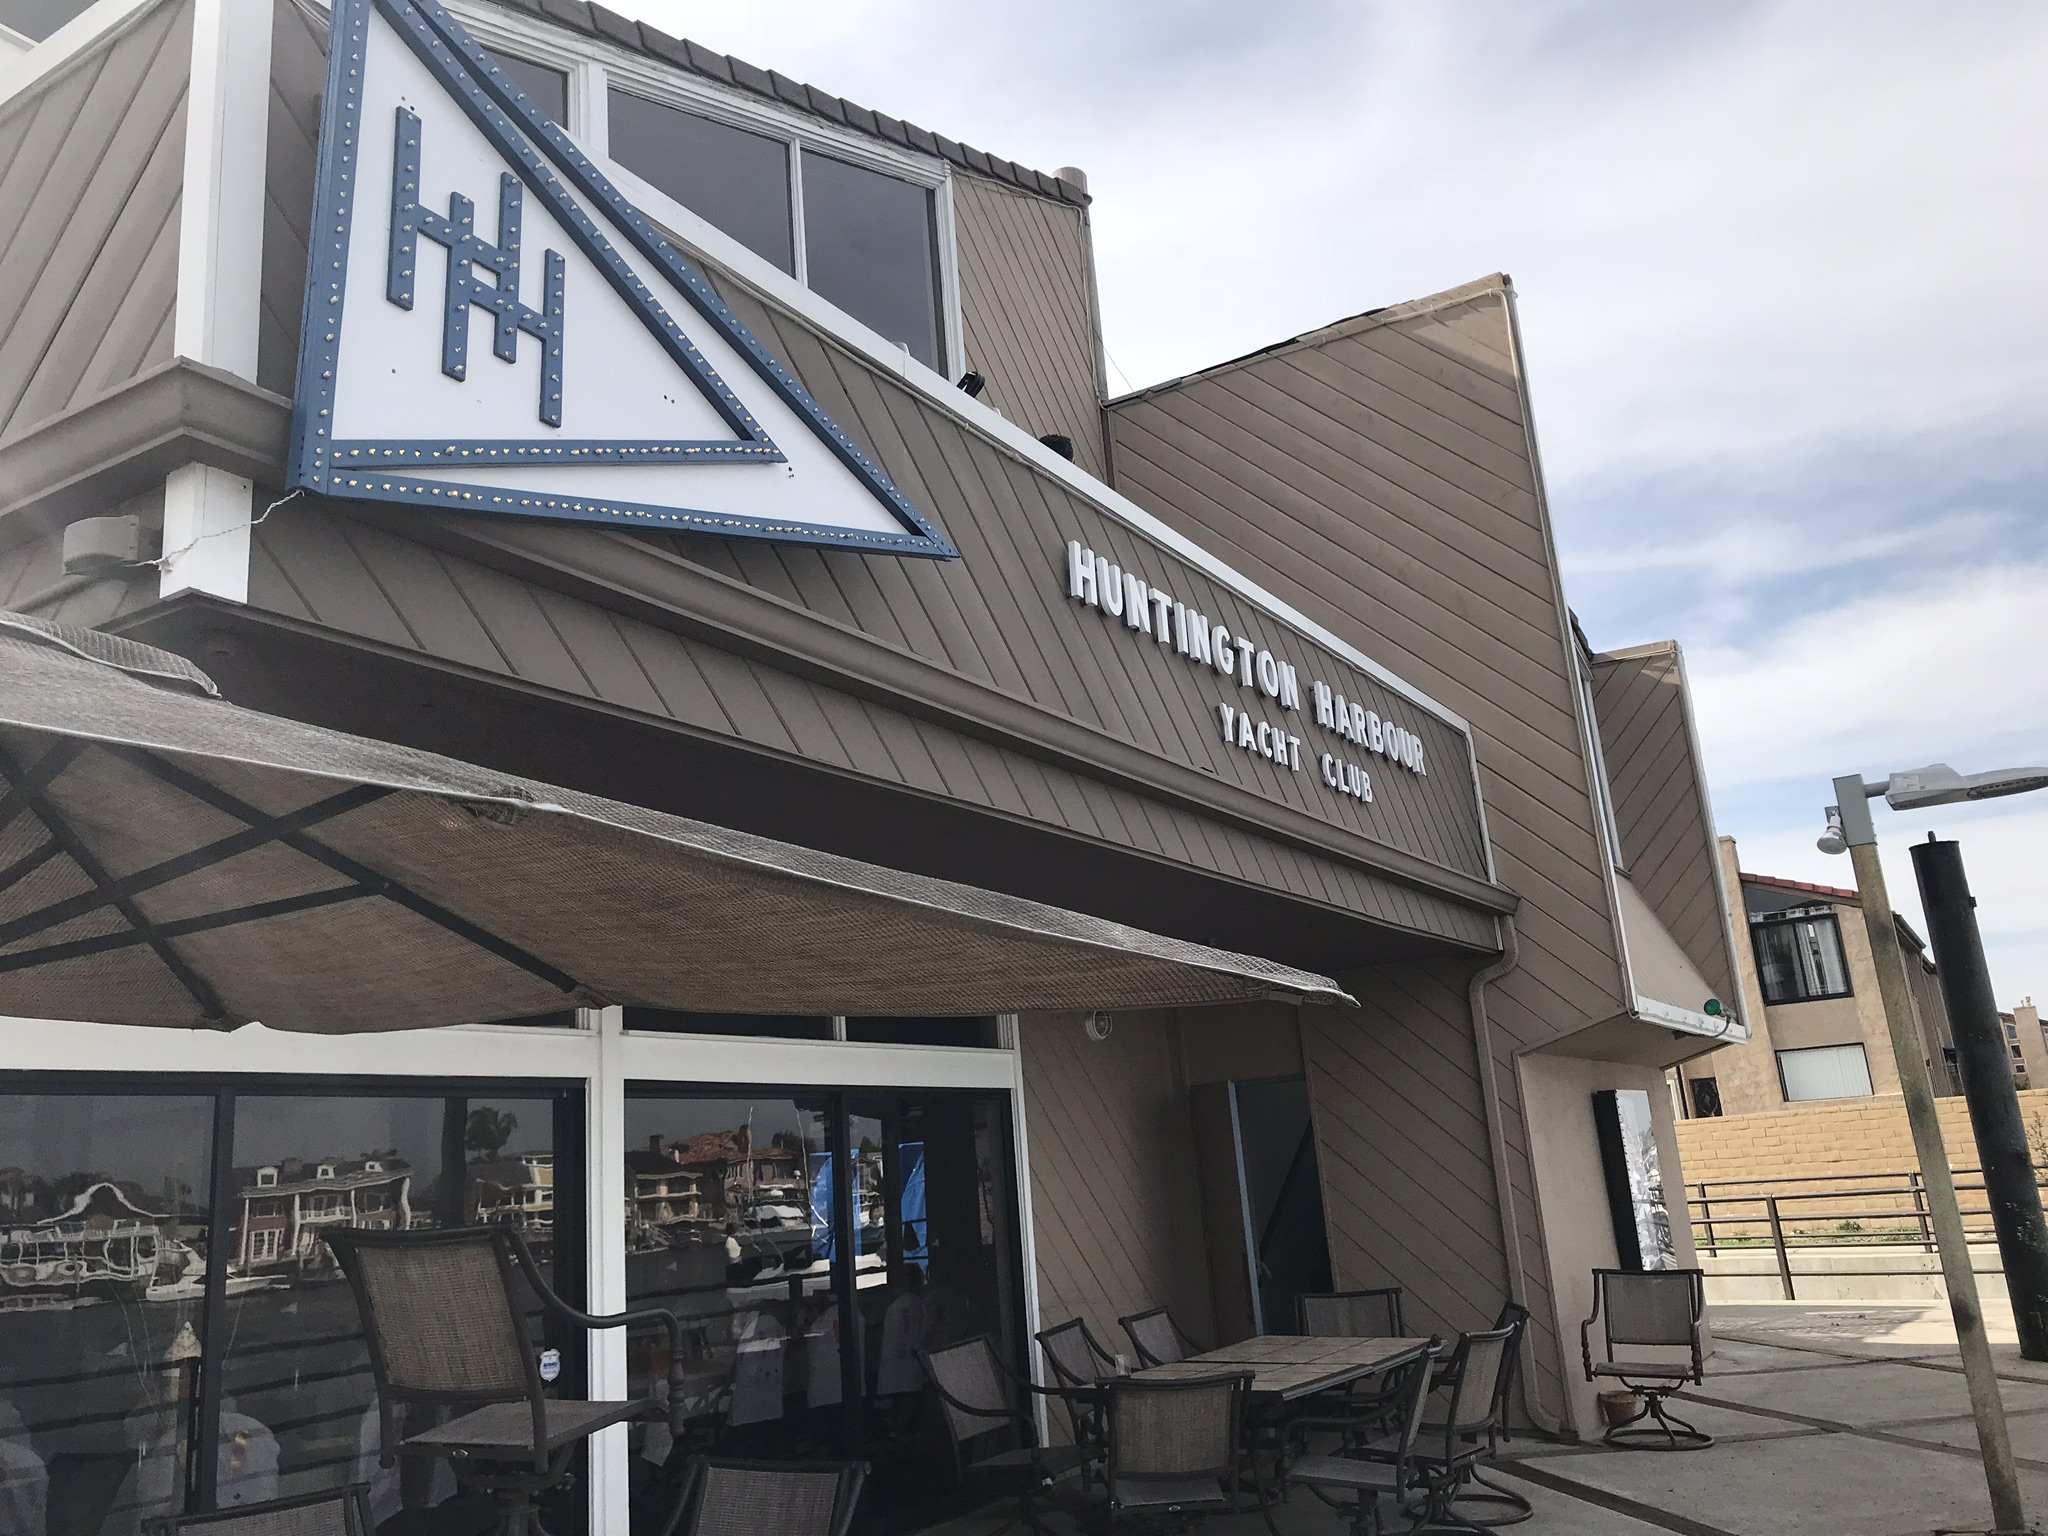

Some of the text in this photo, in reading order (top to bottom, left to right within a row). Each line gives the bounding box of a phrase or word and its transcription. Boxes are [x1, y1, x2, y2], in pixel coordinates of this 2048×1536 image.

[1067, 539, 1427, 776] HUNTINGTON HARBOUR
[1216, 702, 1374, 804] YACHT CLUB
